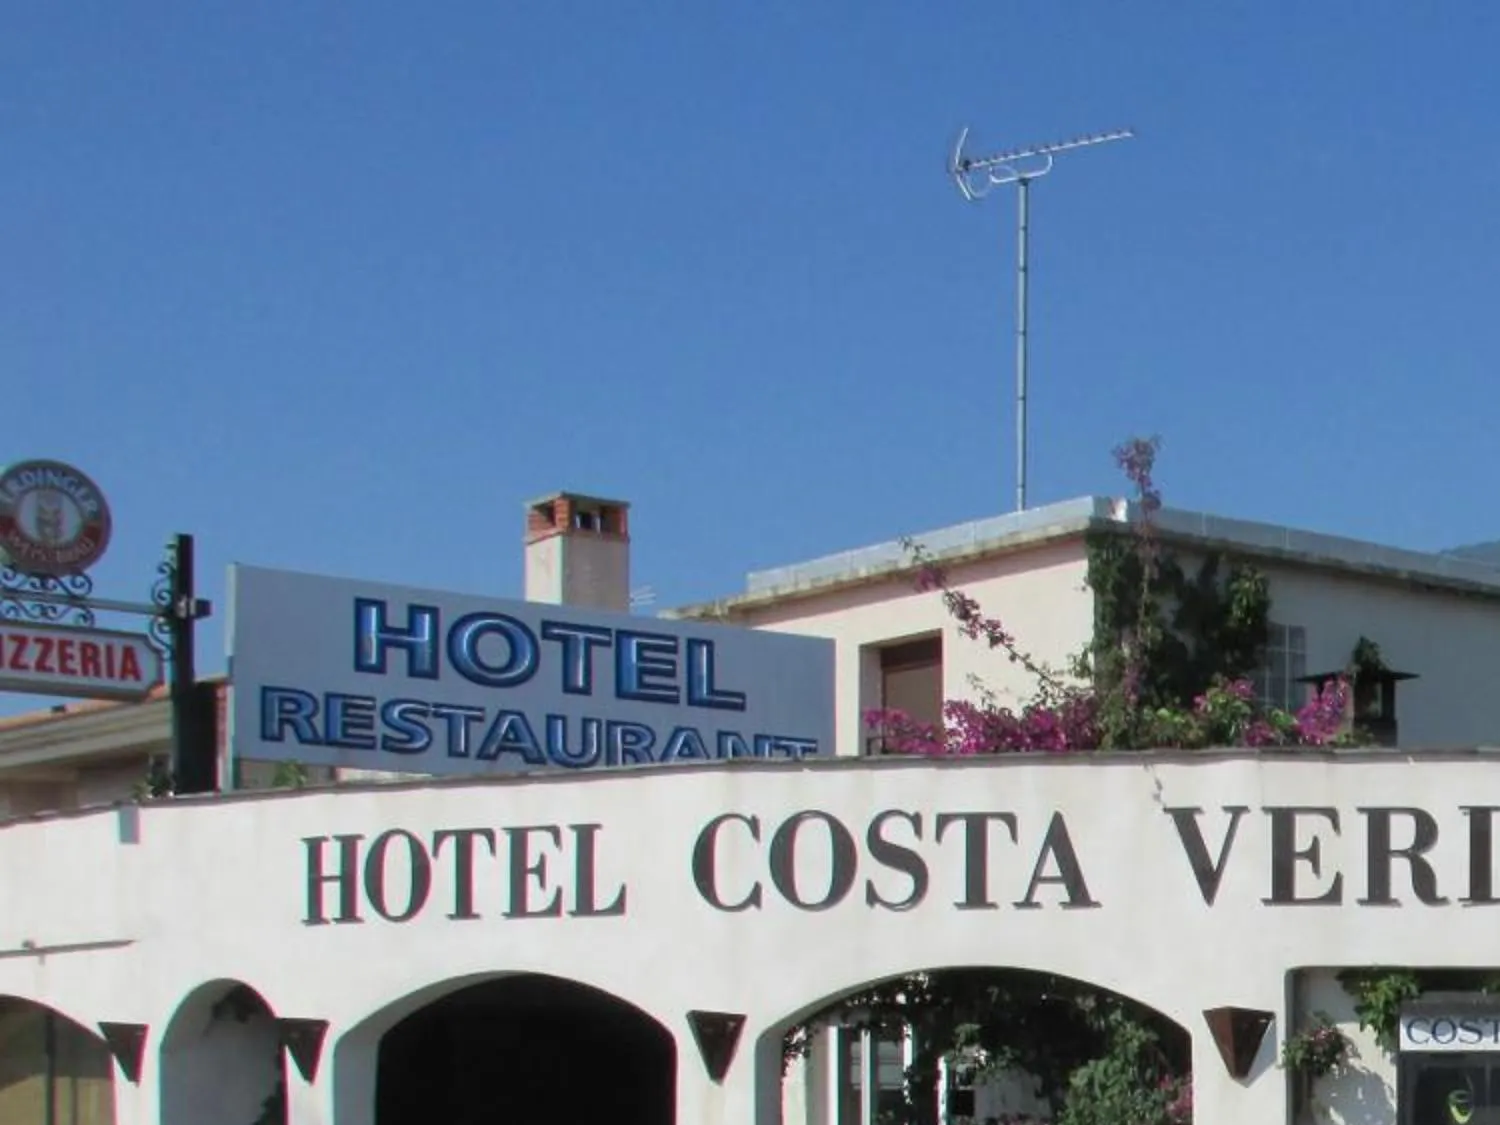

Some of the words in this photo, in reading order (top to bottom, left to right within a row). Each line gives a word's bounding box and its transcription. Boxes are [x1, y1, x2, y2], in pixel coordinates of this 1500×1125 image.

[354, 597, 746, 711] HOTEL
[301, 823, 626, 925] HOTEL
[691, 809, 1102, 912] COSTA
